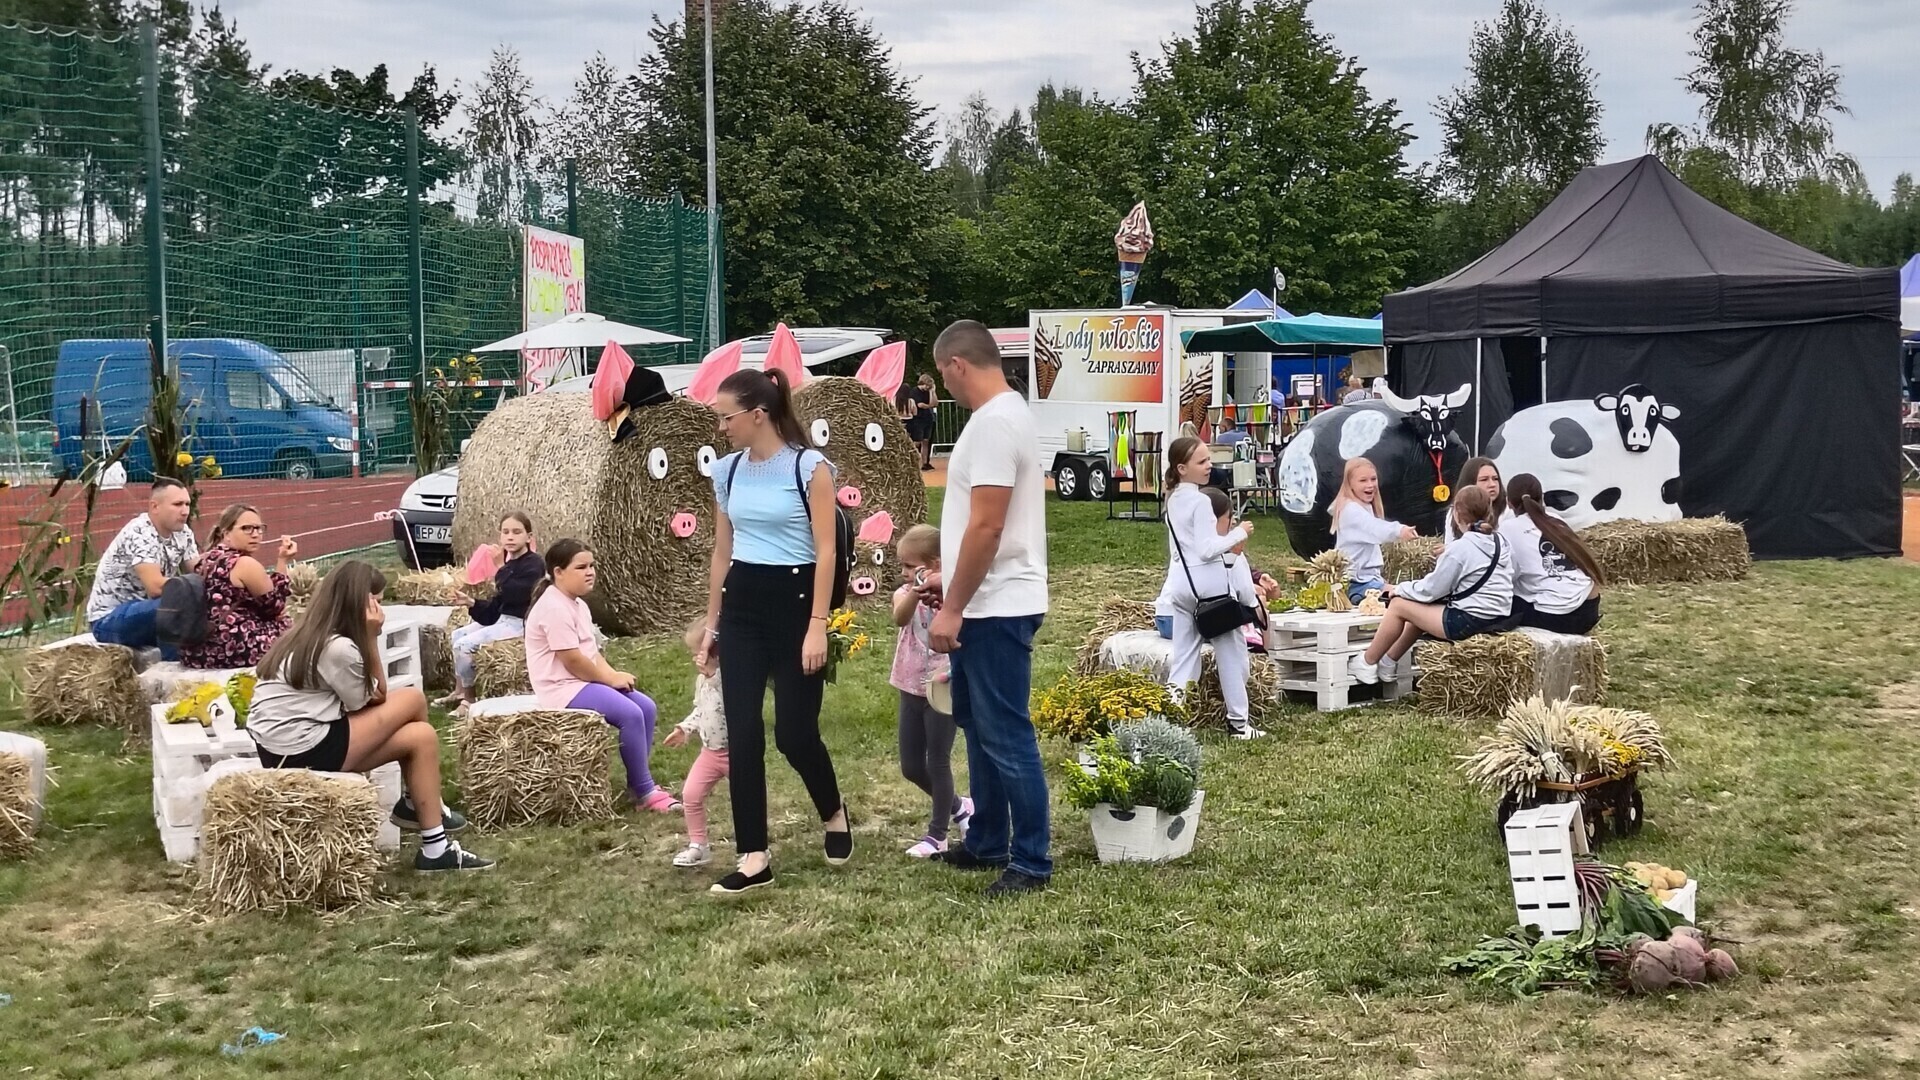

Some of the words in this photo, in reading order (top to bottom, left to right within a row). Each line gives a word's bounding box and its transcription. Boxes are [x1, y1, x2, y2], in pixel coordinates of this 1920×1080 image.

[1053, 320, 1093, 361] Lody
[1100, 317, 1160, 350] włoskie
[1087, 361, 1160, 375] ZAPRASZAMY
[421, 527, 434, 539] EP
